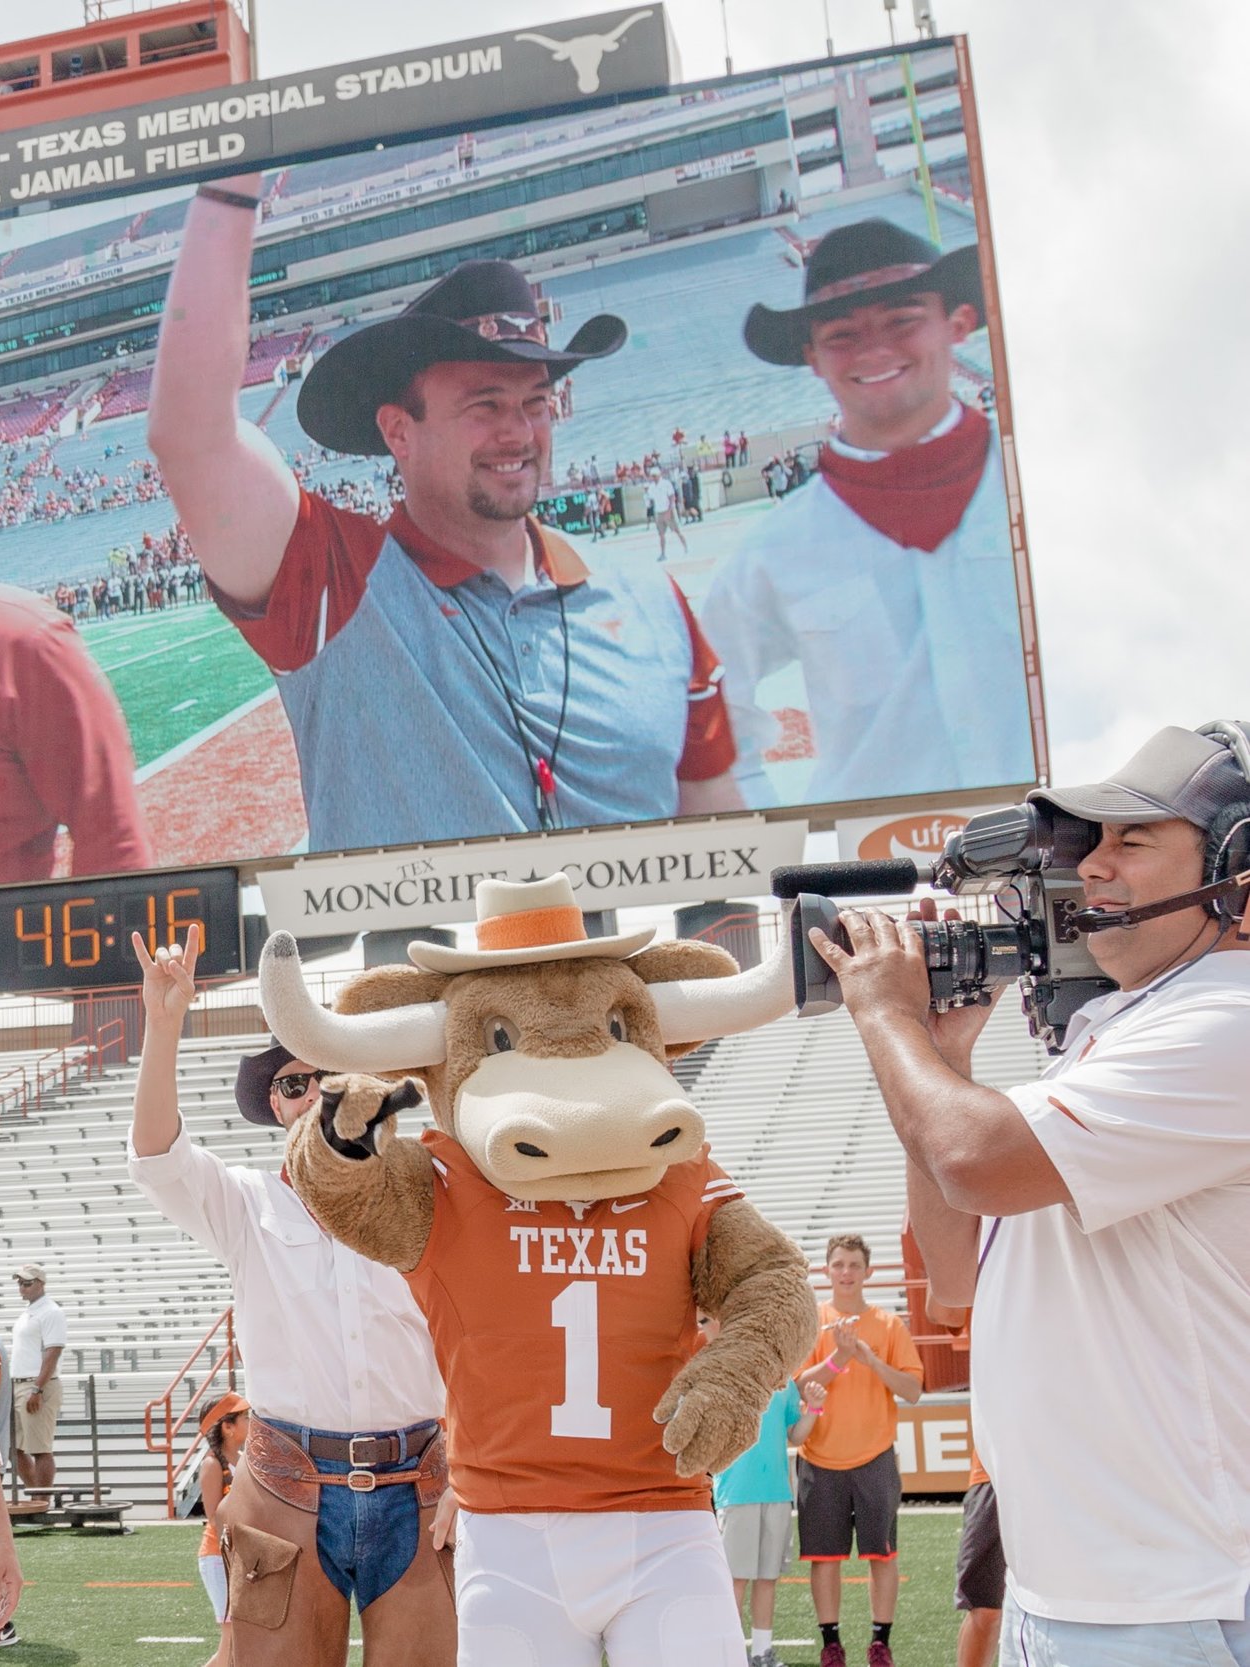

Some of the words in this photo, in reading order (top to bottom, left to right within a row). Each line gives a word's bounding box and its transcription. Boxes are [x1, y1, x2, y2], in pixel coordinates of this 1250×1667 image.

[17, 121, 126, 163] TEXAS
[138, 83, 325, 140] MEMORIAL
[335, 46, 502, 100] STADIUM
[10, 156, 135, 200] JAMAIL
[146, 133, 246, 174] FIELD
[397, 857, 435, 879] TEX
[510, 1226, 647, 1276] TEXAS
[551, 1281, 612, 1439] 1
